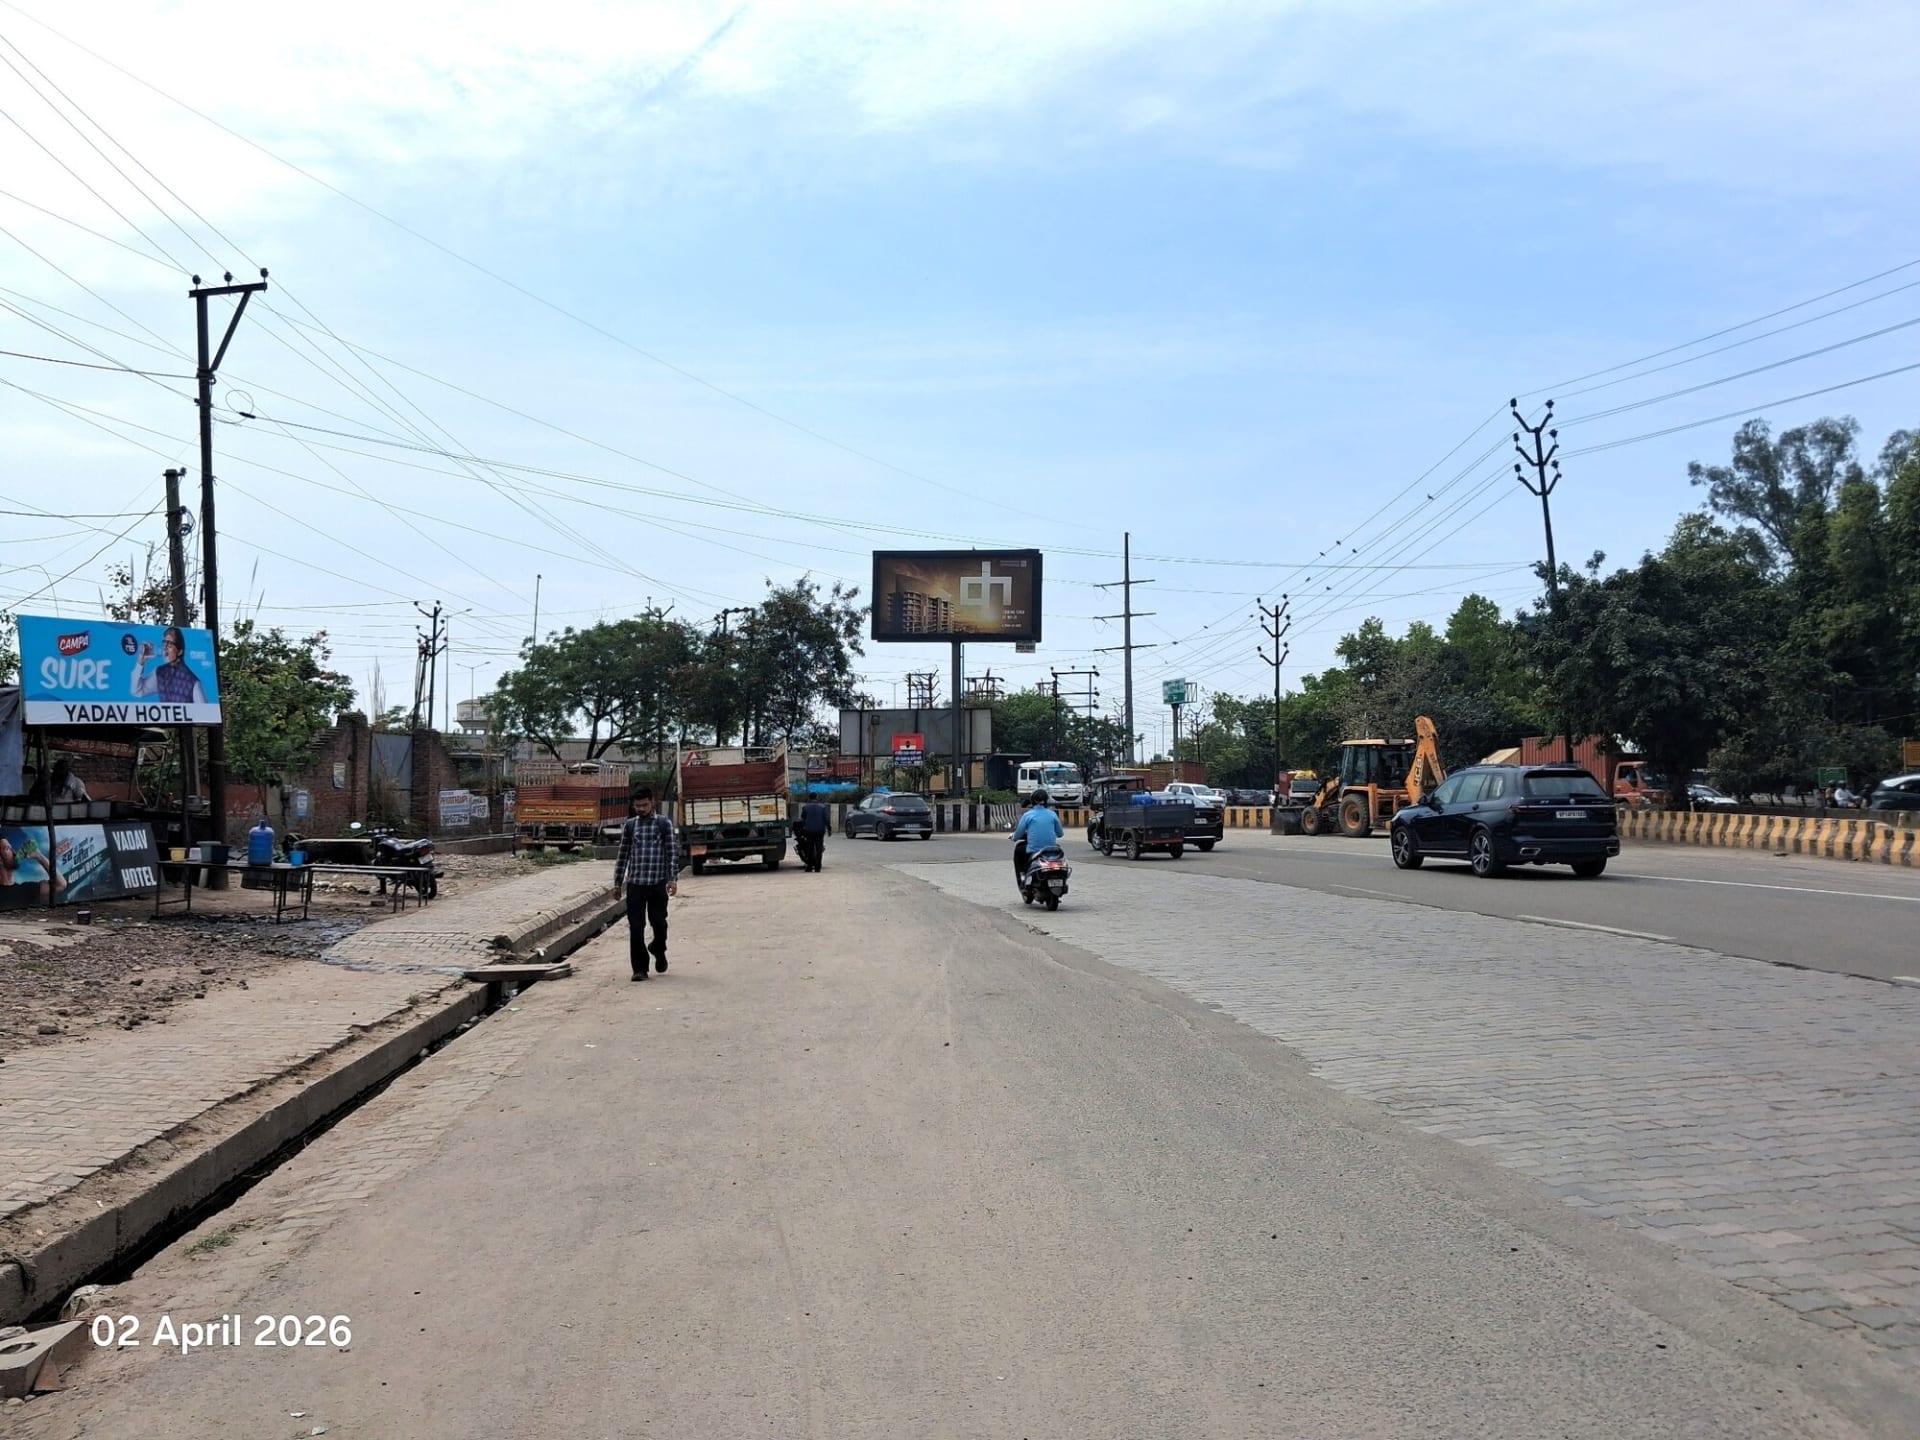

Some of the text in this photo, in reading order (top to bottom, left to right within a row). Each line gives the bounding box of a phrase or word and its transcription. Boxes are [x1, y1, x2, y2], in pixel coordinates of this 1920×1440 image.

[59, 633, 90, 651] CAMPA
[39, 656, 112, 690] SURE
[64, 704, 193, 722] YADAV HOTEL
[112, 830, 148, 851] YADAV
[121, 867, 157, 888] HOTEL
